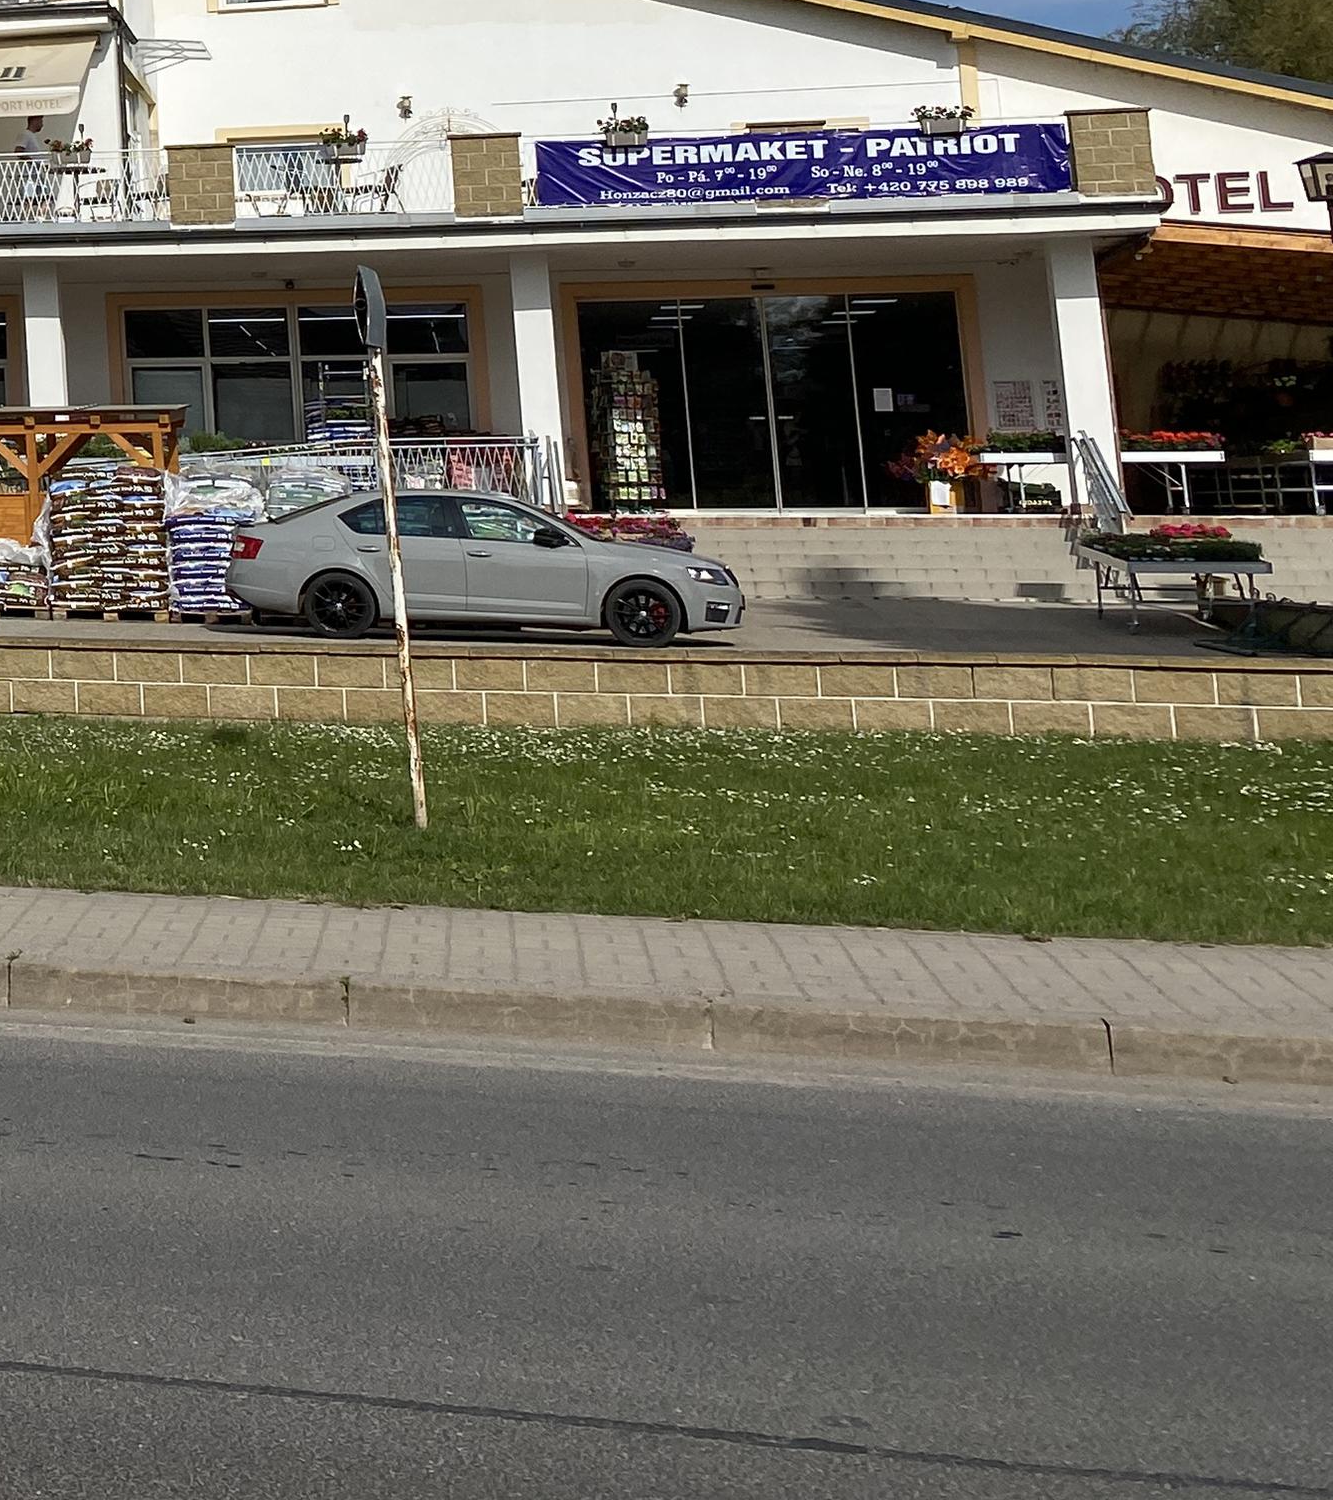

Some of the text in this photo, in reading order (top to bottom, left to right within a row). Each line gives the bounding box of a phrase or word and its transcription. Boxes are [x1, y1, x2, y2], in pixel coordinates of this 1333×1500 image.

[26, 99, 62, 110] HOTEL
[578, 139, 828, 167] SUPERMAKET
[866, 133, 1020, 158] PATRIOT
[656, 172, 674, 184] Po
[688, 169, 711, 183] Pá.
[811, 166, 829, 178] So
[843, 164, 867, 178] Ne.
[864, 181, 911, 192] +420
